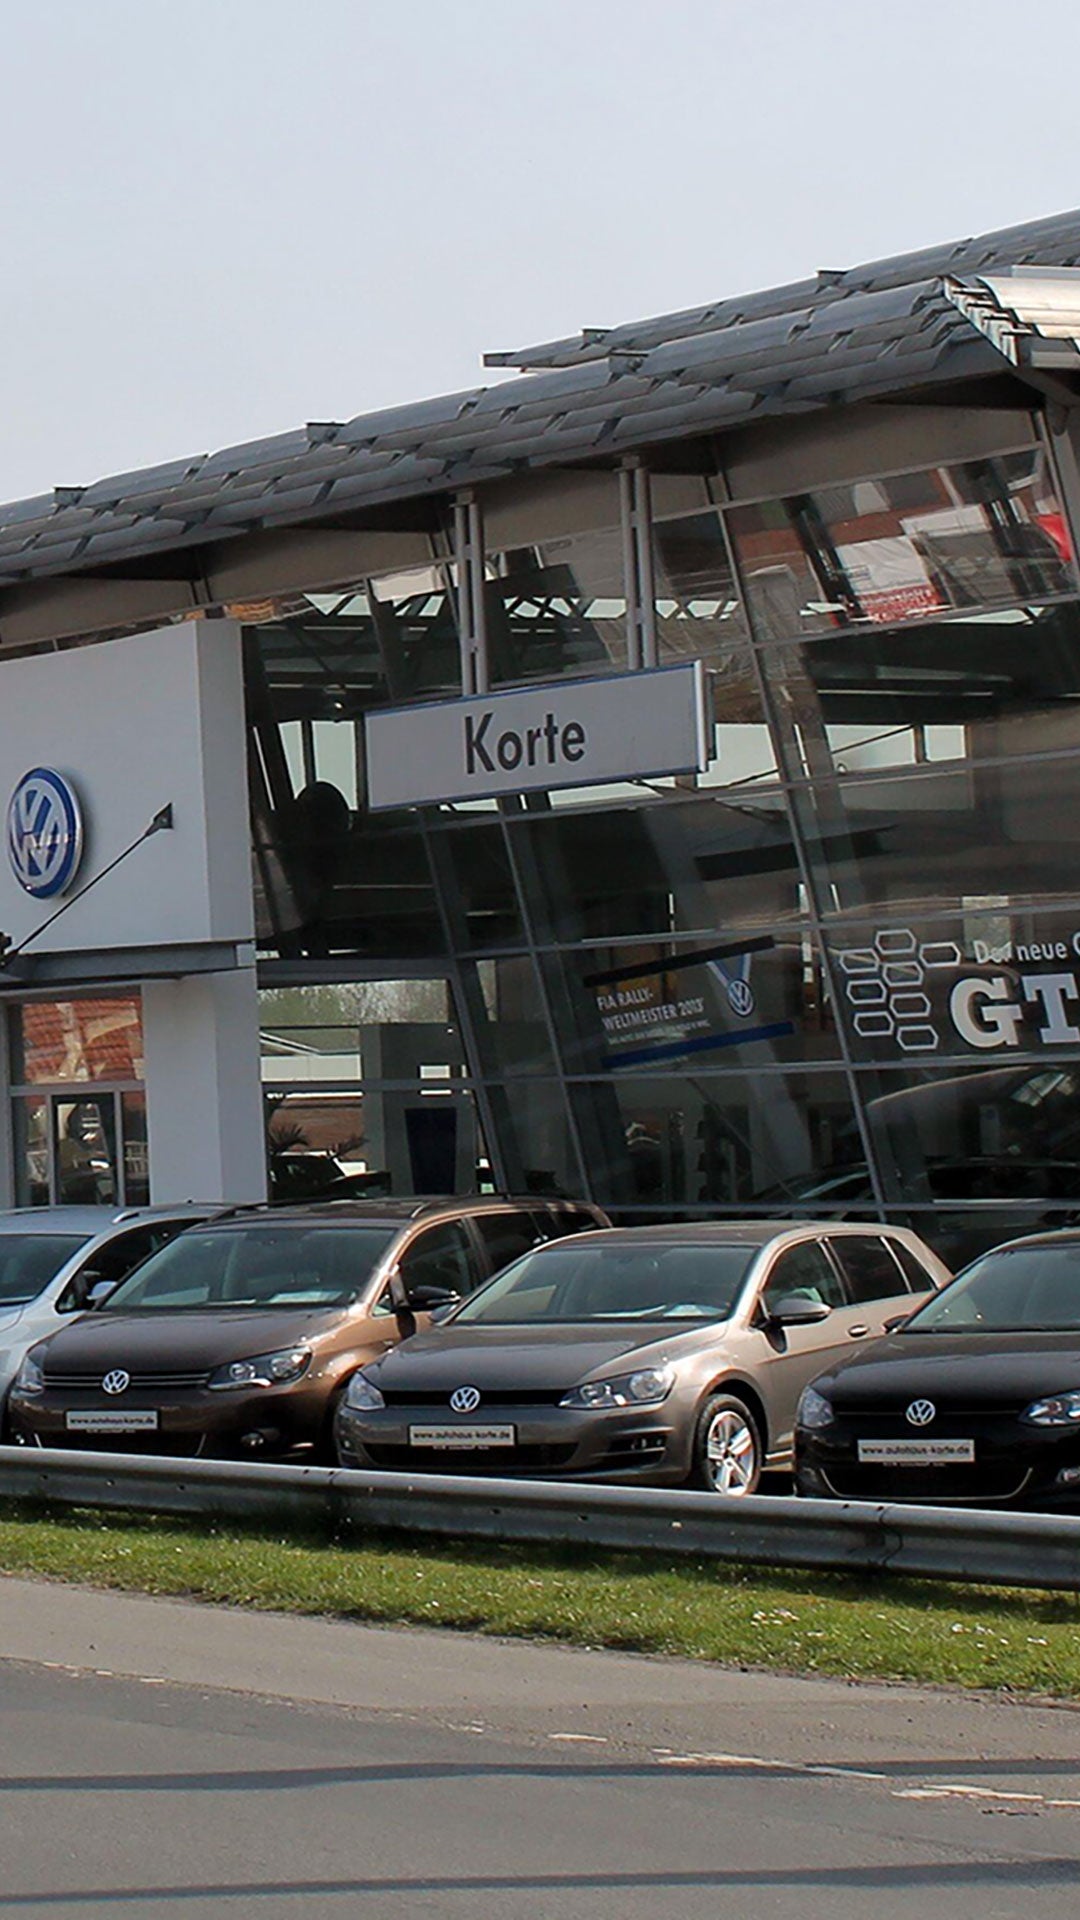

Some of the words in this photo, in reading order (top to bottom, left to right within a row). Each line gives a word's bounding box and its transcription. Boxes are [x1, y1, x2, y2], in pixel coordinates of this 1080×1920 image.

[464, 711, 586, 775] Korte
[1015, 941, 1068, 962] neue
[596, 991, 618, 1011] FIA
[618, 987, 654, 1006] RALLY-
[602, 1003, 678, 1031] WELTMEISTER
